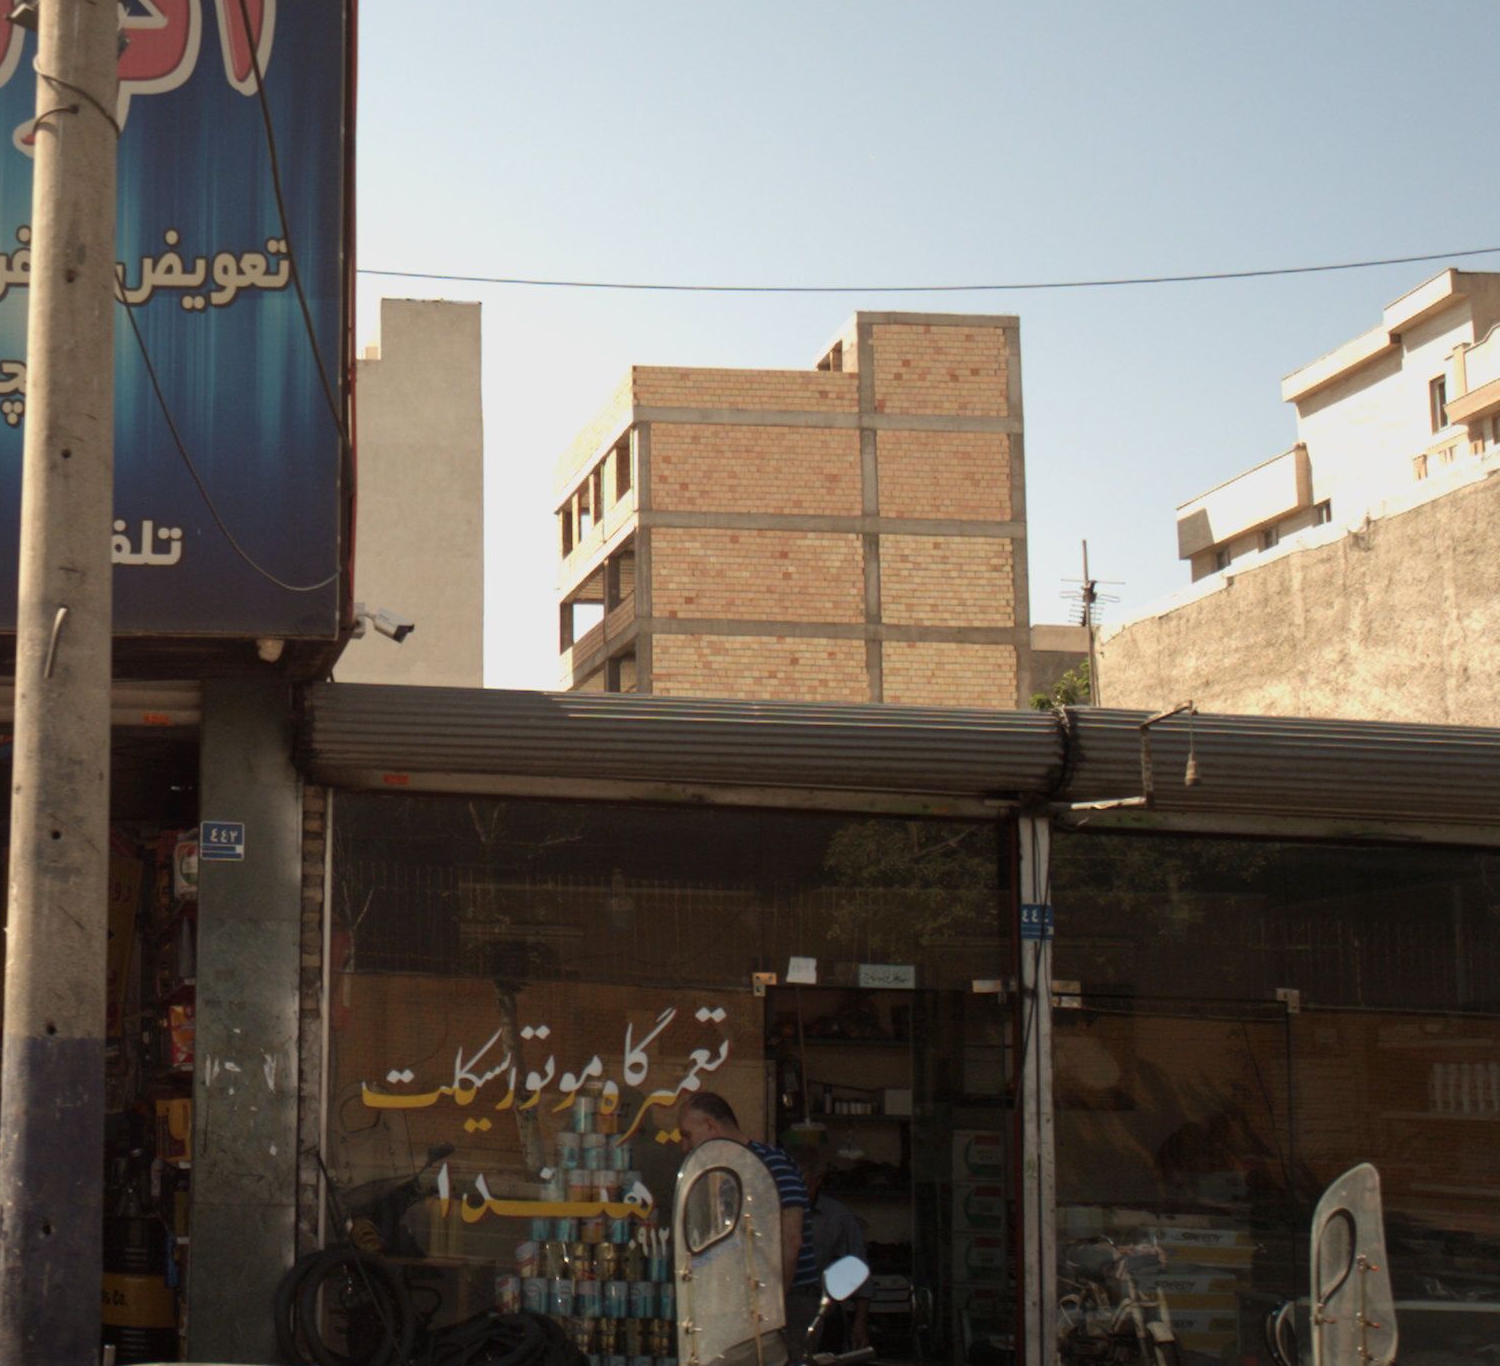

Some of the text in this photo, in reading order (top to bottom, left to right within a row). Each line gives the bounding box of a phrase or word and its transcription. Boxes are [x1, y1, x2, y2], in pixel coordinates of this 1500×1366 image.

[114, 227, 293, 311] تعویض
[111, 518, 184, 567] تلف
[437, 1161, 655, 1224] هندا
